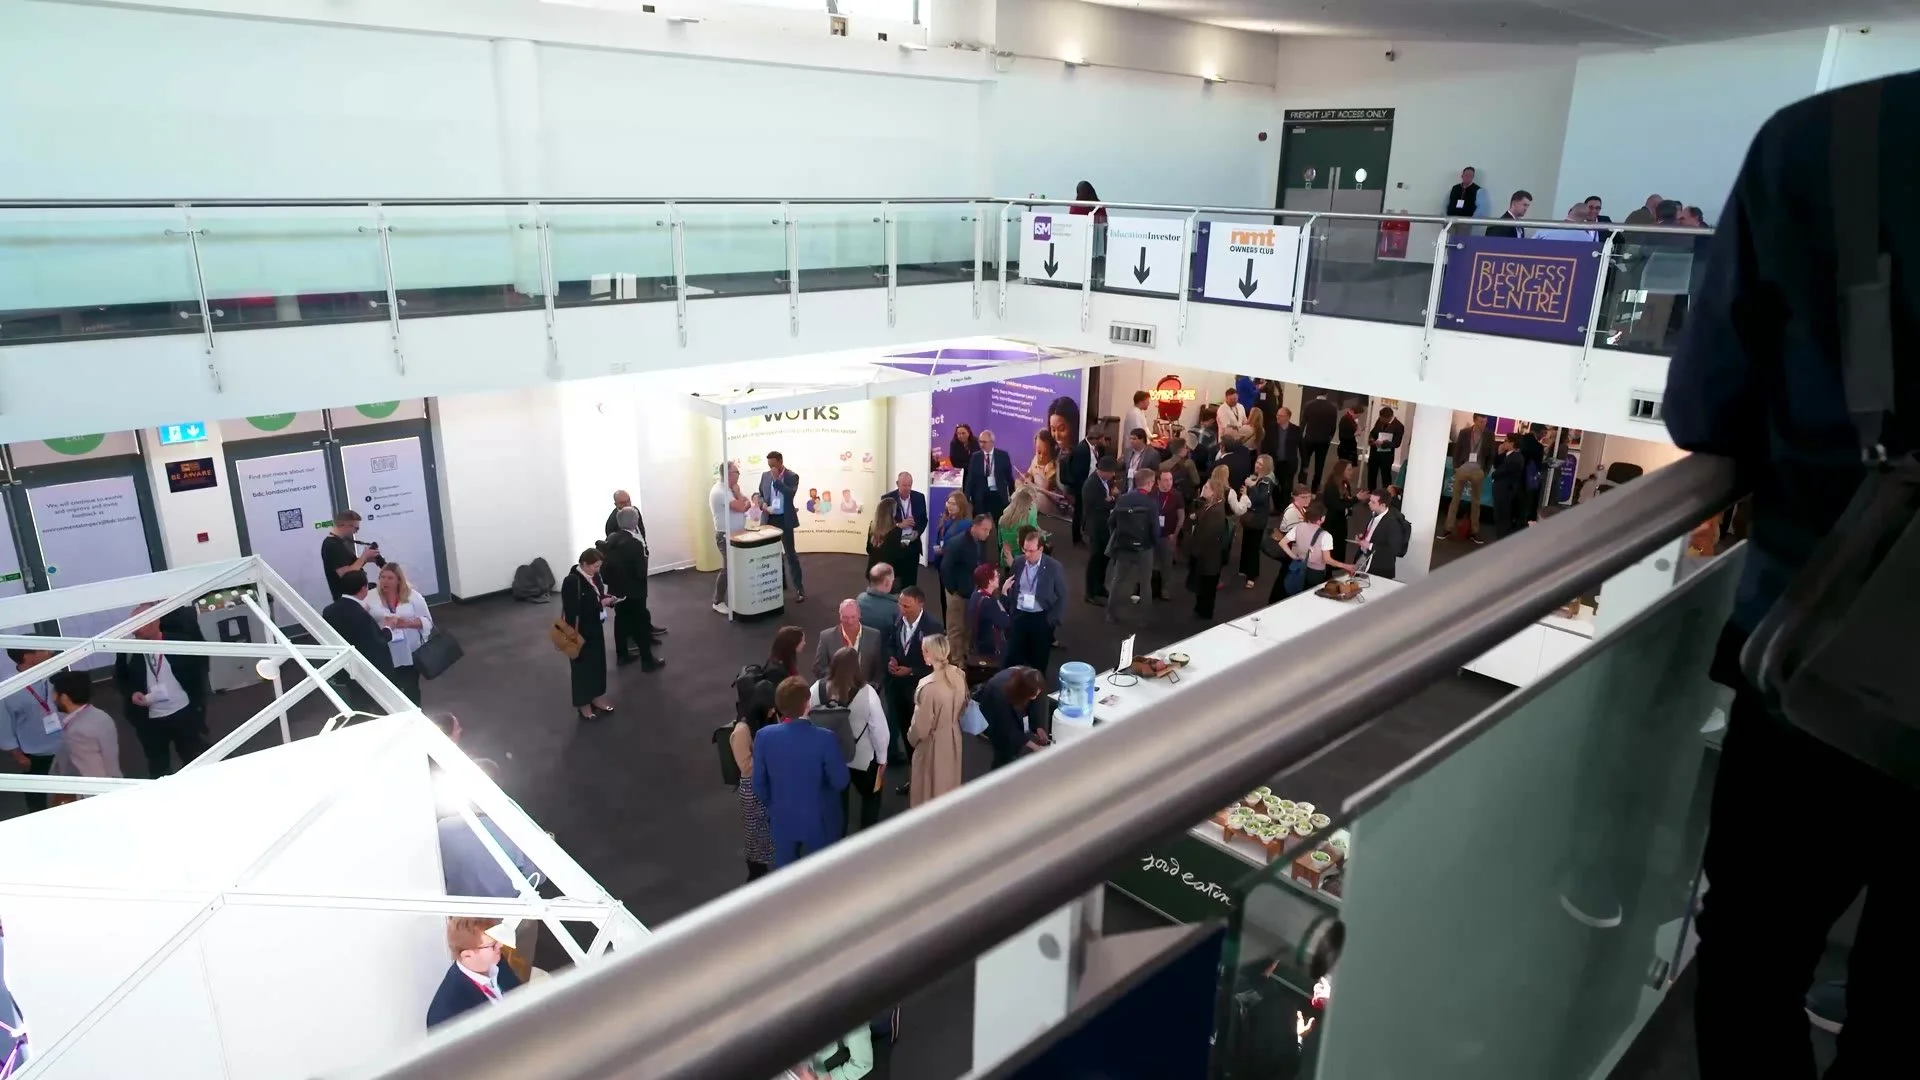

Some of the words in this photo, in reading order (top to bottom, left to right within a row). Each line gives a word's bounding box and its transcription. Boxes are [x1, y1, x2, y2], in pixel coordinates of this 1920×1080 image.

[1366, 110, 1387, 118] ONLY
[1034, 223, 1050, 235] ISM
[1231, 229, 1275, 246] nmt
[1230, 246, 1258, 254] OWNERS
[1481, 260, 1566, 282] BUSINESS
[1478, 273, 1562, 295] DESIGN
[1476, 290, 1560, 314] CENTRE
[1149, 390, 1173, 400] WIN
[1177, 390, 1196, 400] ME
[184, 470, 212, 479] AWARE
[252, 484, 316, 497] bdc.london/net-zero
[1182, 872, 1232, 906] eatin
